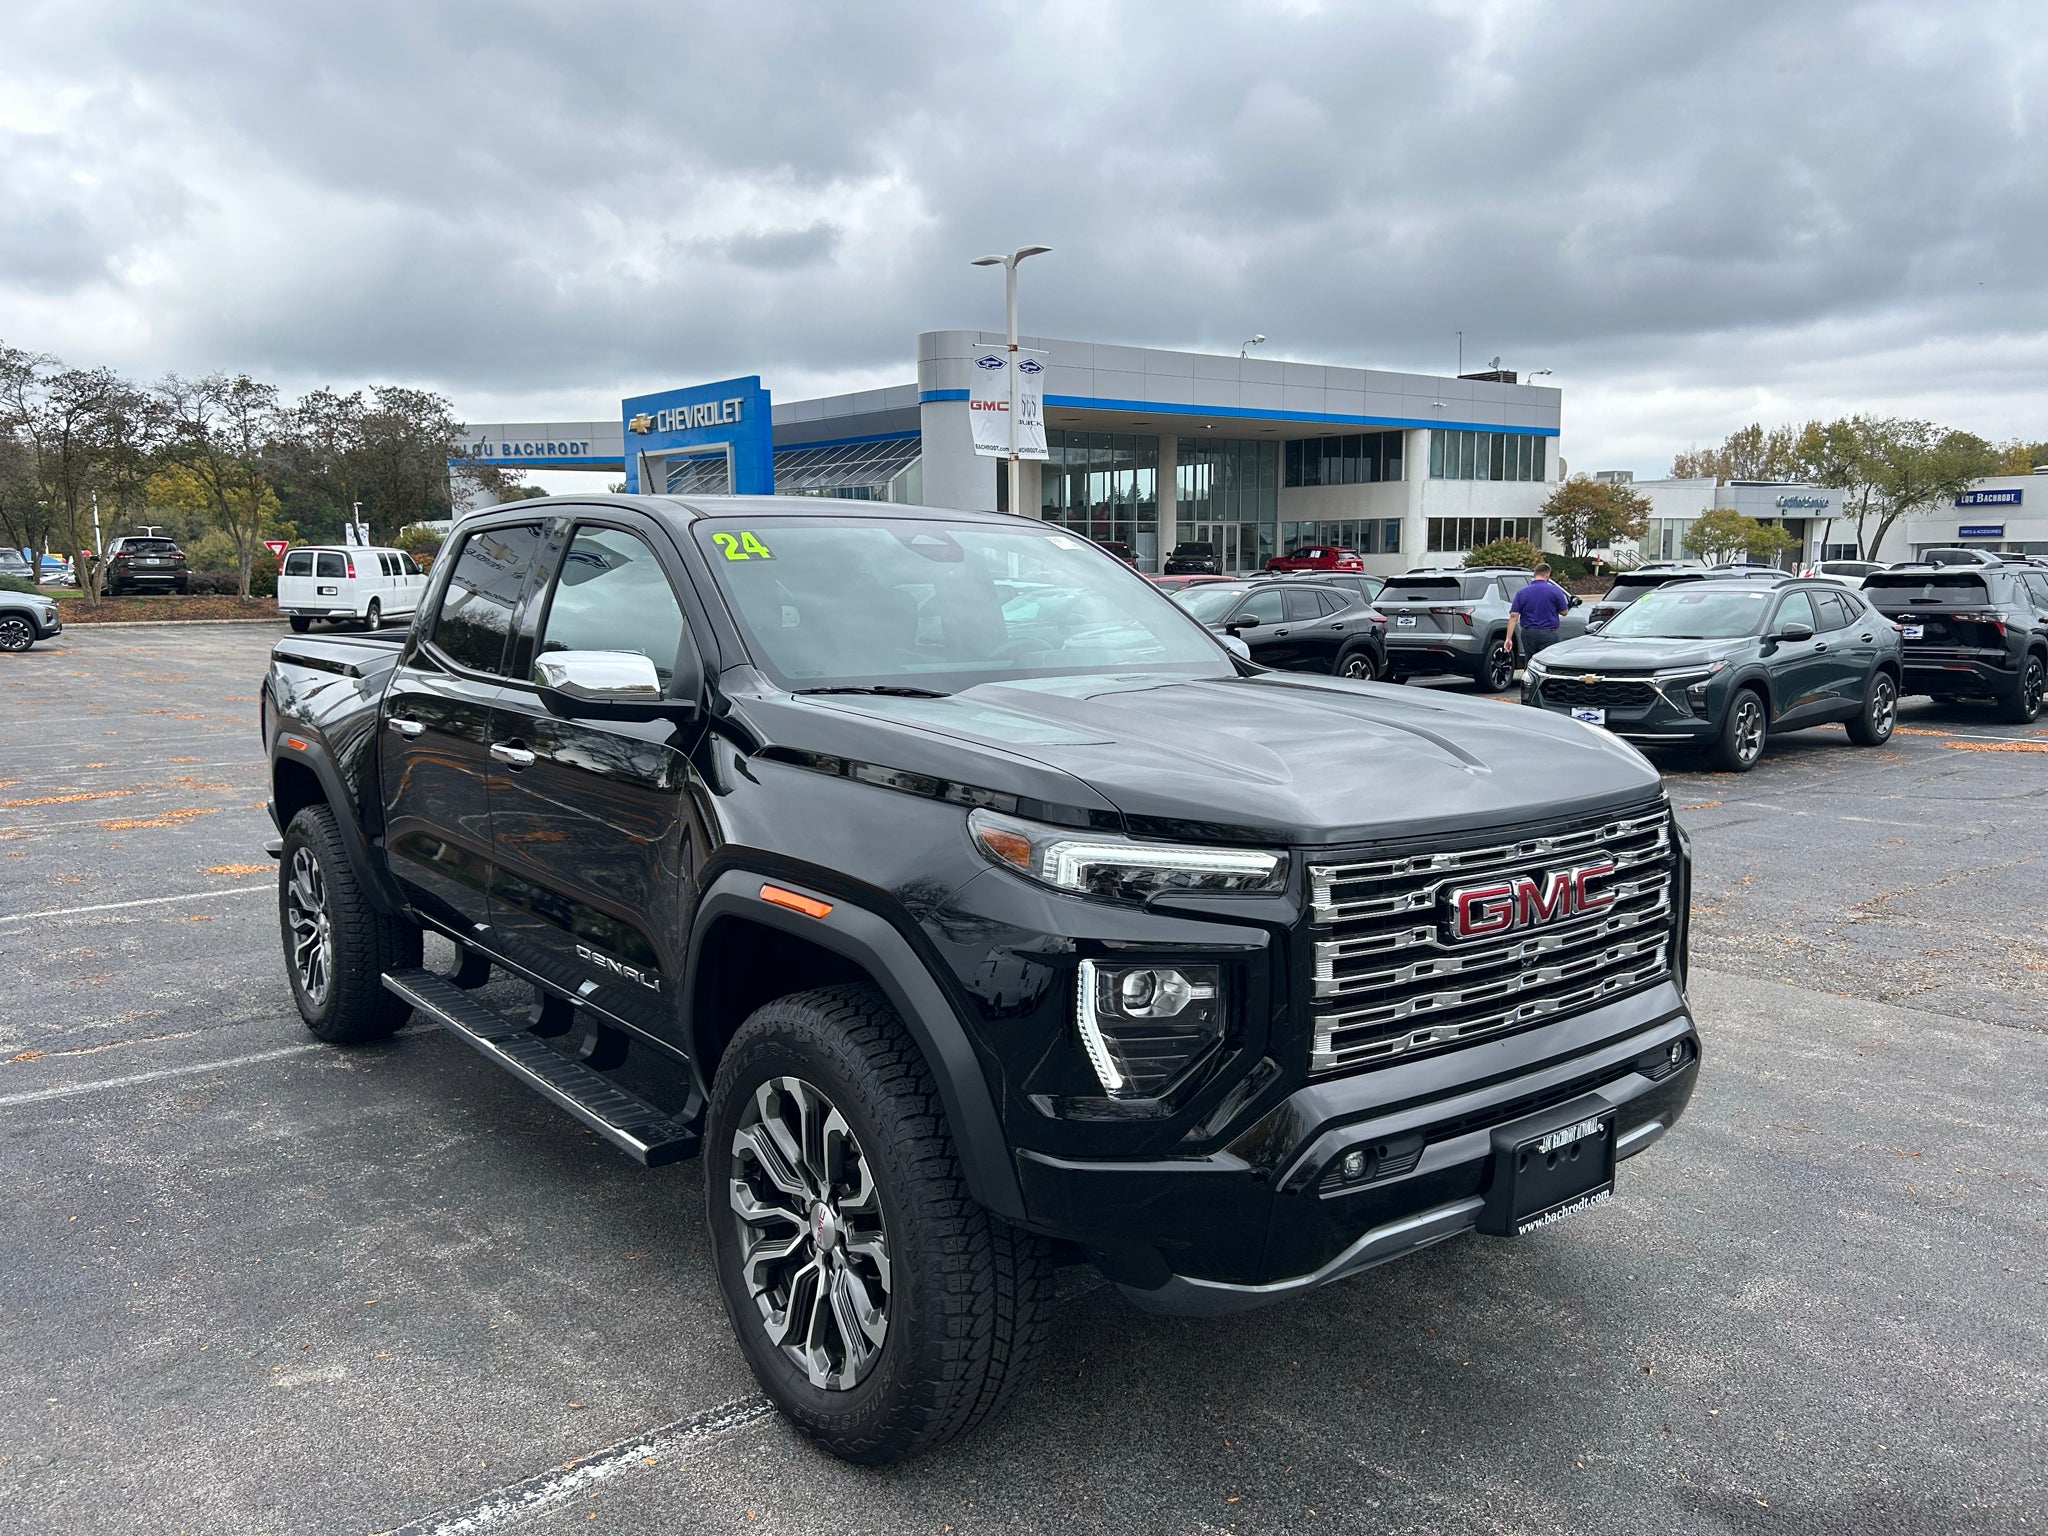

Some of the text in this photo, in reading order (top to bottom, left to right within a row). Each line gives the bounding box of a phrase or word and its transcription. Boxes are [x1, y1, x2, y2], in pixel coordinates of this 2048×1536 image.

[657, 397, 744, 433] CHEVROLET
[970, 400, 1009, 411] GMC
[502, 441, 590, 456] BACHRODT
[1961, 493, 2015, 504] LOU BACHRODT
[712, 531, 771, 561] 24
[1452, 862, 1616, 940] GMC
[576, 944, 660, 992] DENALI
[817, 1208, 826, 1245] GMC
[1518, 1189, 1610, 1235] www.bachrodt.com
